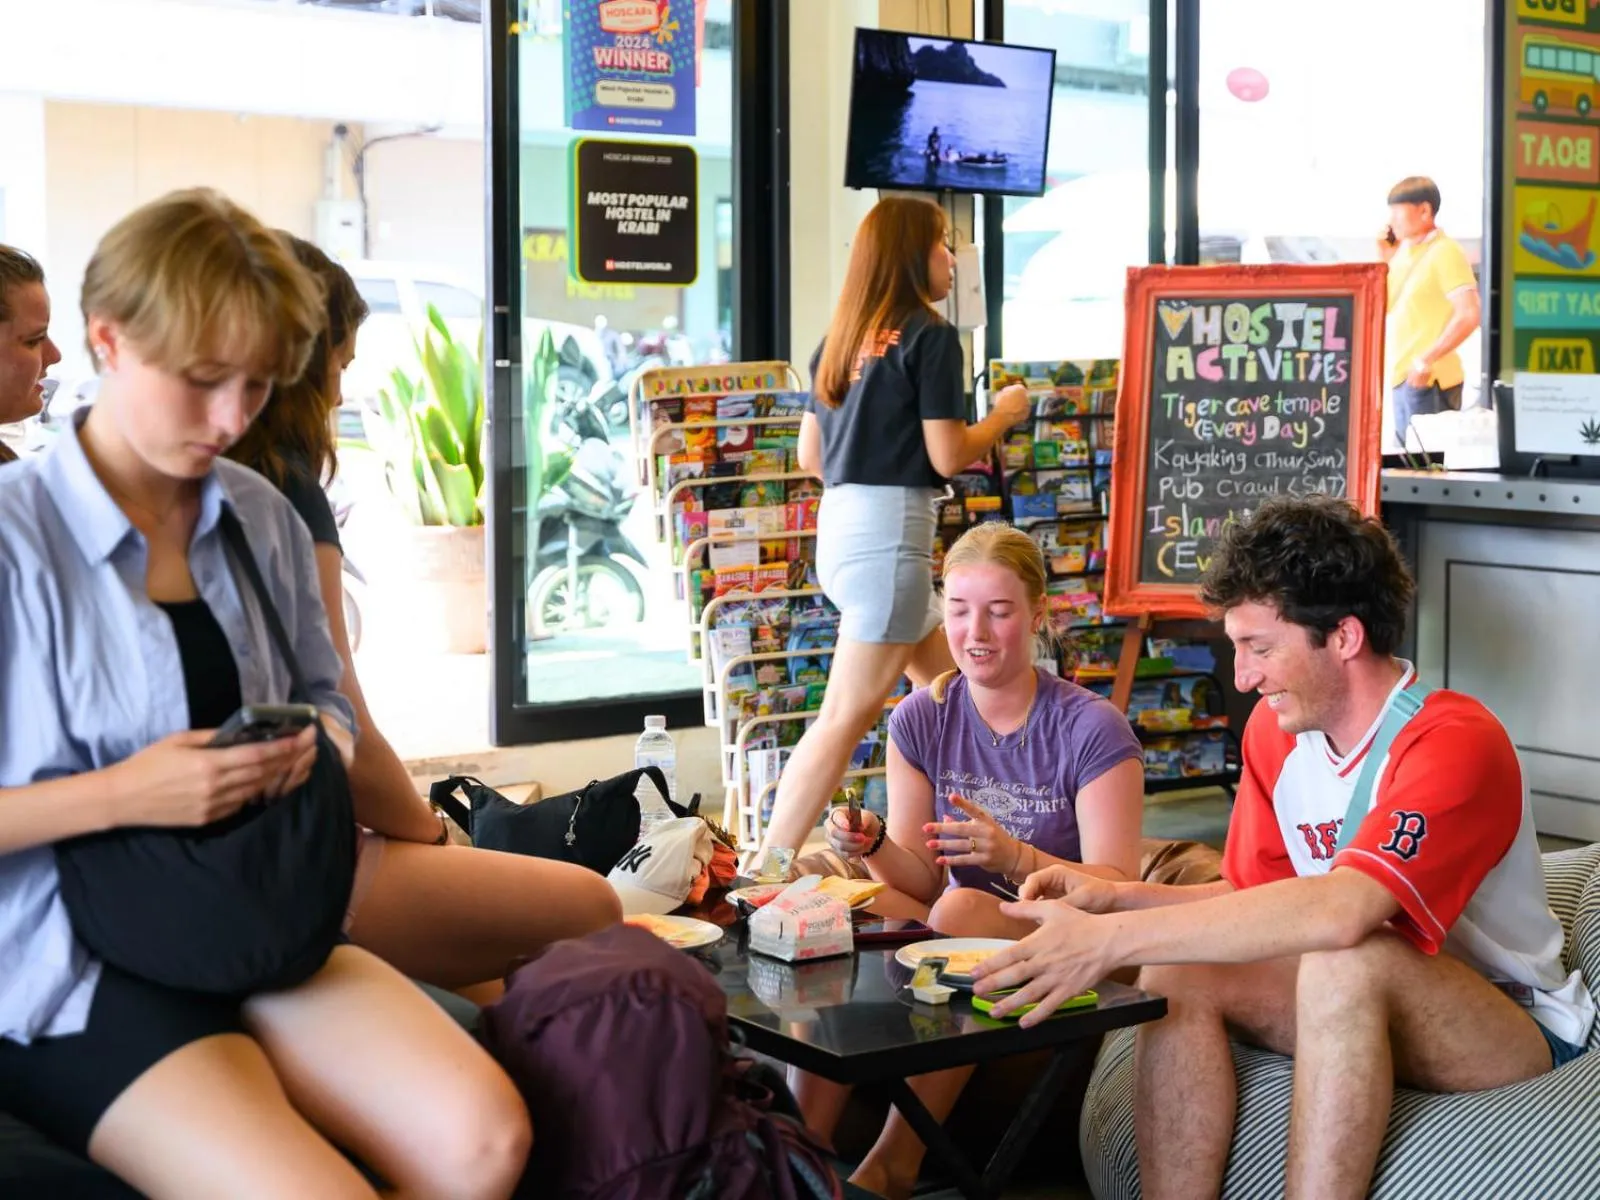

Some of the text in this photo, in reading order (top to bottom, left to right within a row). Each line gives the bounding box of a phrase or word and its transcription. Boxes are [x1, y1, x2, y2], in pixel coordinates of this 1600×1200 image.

[615, 35, 650, 49] 2024
[592, 46, 672, 72] WINNER
[587, 191, 689, 210] MOST POPULAR
[605, 206, 672, 222] HOSTEL IN
[617, 220, 661, 235] KRABI
[523, 233, 568, 262] KRA
[613, 260, 673, 272] HOSTELWORLD
[1191, 302, 1347, 351] HOSTEL
[653, 372, 775, 396] PLAYGROUND
[1161, 387, 1341, 428] Tiger cave temple
[1154, 438, 1247, 478] Kayaking
[1159, 476, 1204, 501] Pub
[1156, 541, 1213, 578] (Ev
[1297, 818, 1344, 861] RE
[1378, 809, 1428, 862] B
